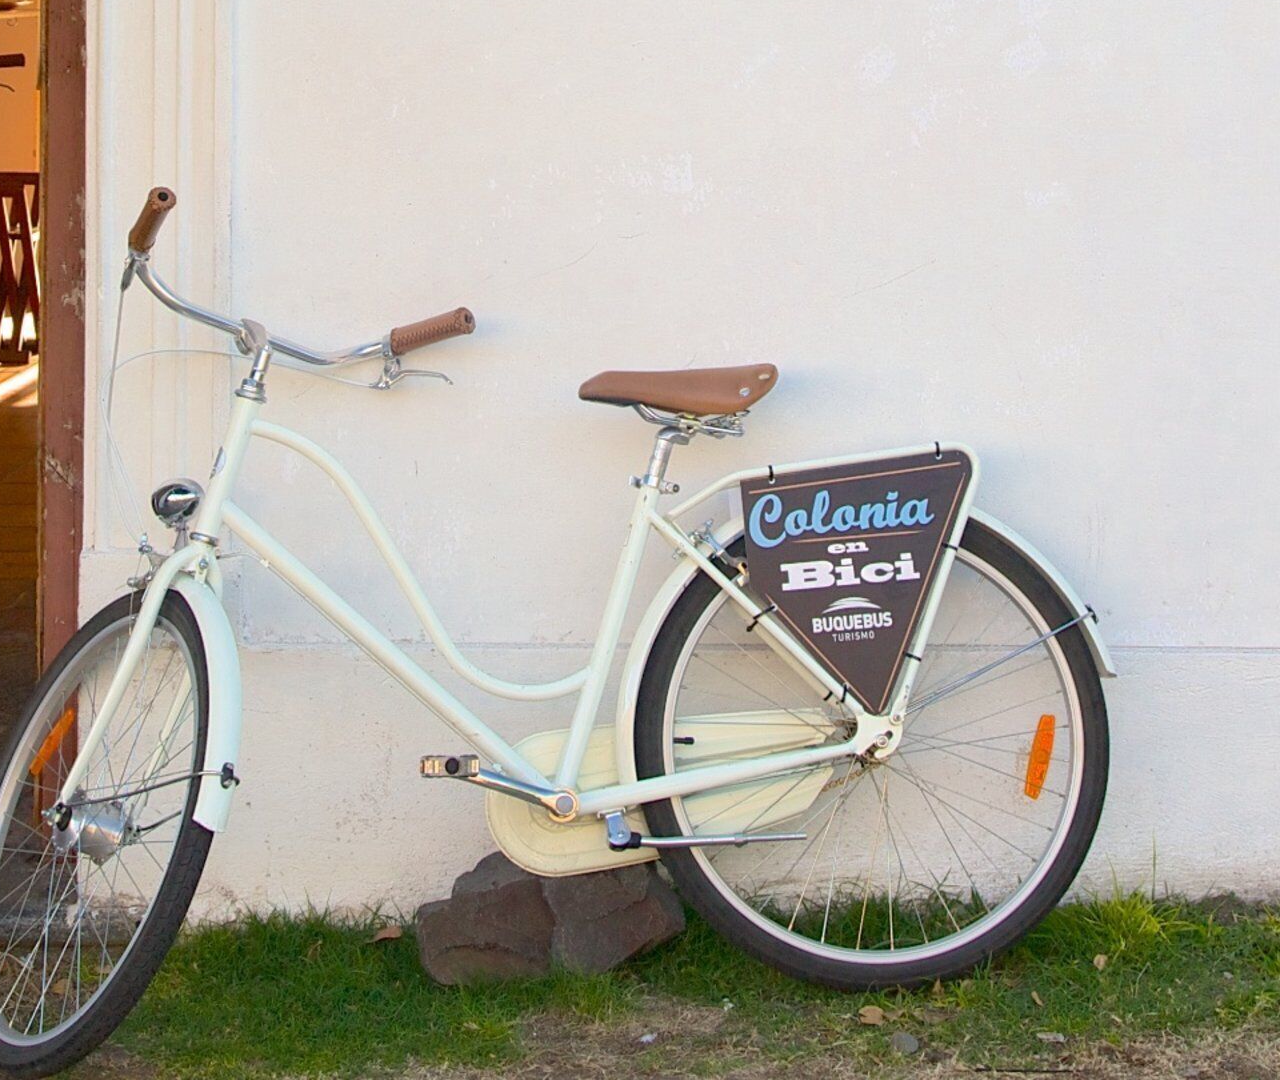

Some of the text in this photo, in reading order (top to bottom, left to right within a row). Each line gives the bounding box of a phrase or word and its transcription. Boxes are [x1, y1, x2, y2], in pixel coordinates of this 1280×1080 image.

[749, 489, 935, 548] Colonia
[827, 541, 869, 554] en
[780, 552, 920, 591] Bici
[811, 611, 893, 633] BUQUEBUS
[832, 631, 875, 642] TURISMO
